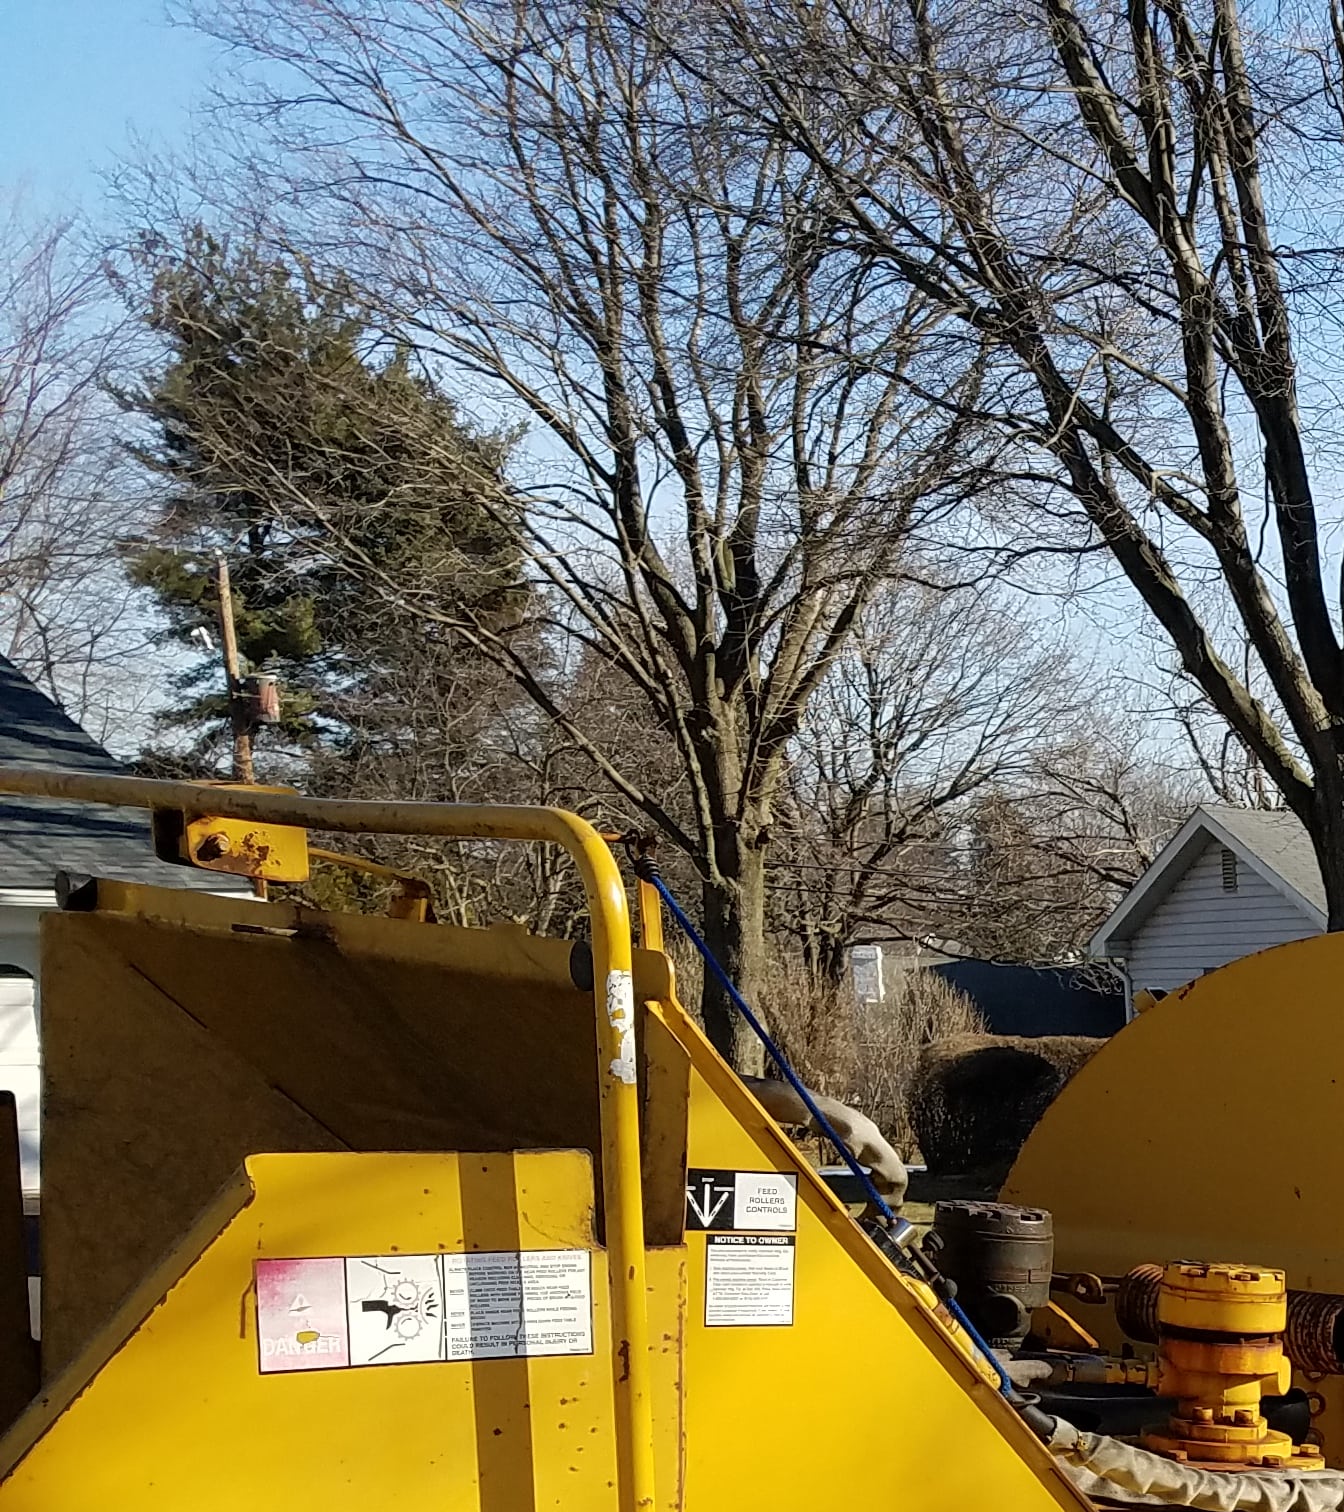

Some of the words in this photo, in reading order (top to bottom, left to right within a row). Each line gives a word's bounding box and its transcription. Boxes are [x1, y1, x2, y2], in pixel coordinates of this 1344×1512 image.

[749, 1197, 785, 1205] ROLLERS
[745, 1206, 788, 1214] CONTROLS
[714, 1236, 745, 1244] NOTICE
[745, 1236, 757, 1244] TO
[758, 1236, 789, 1245] OWNER
